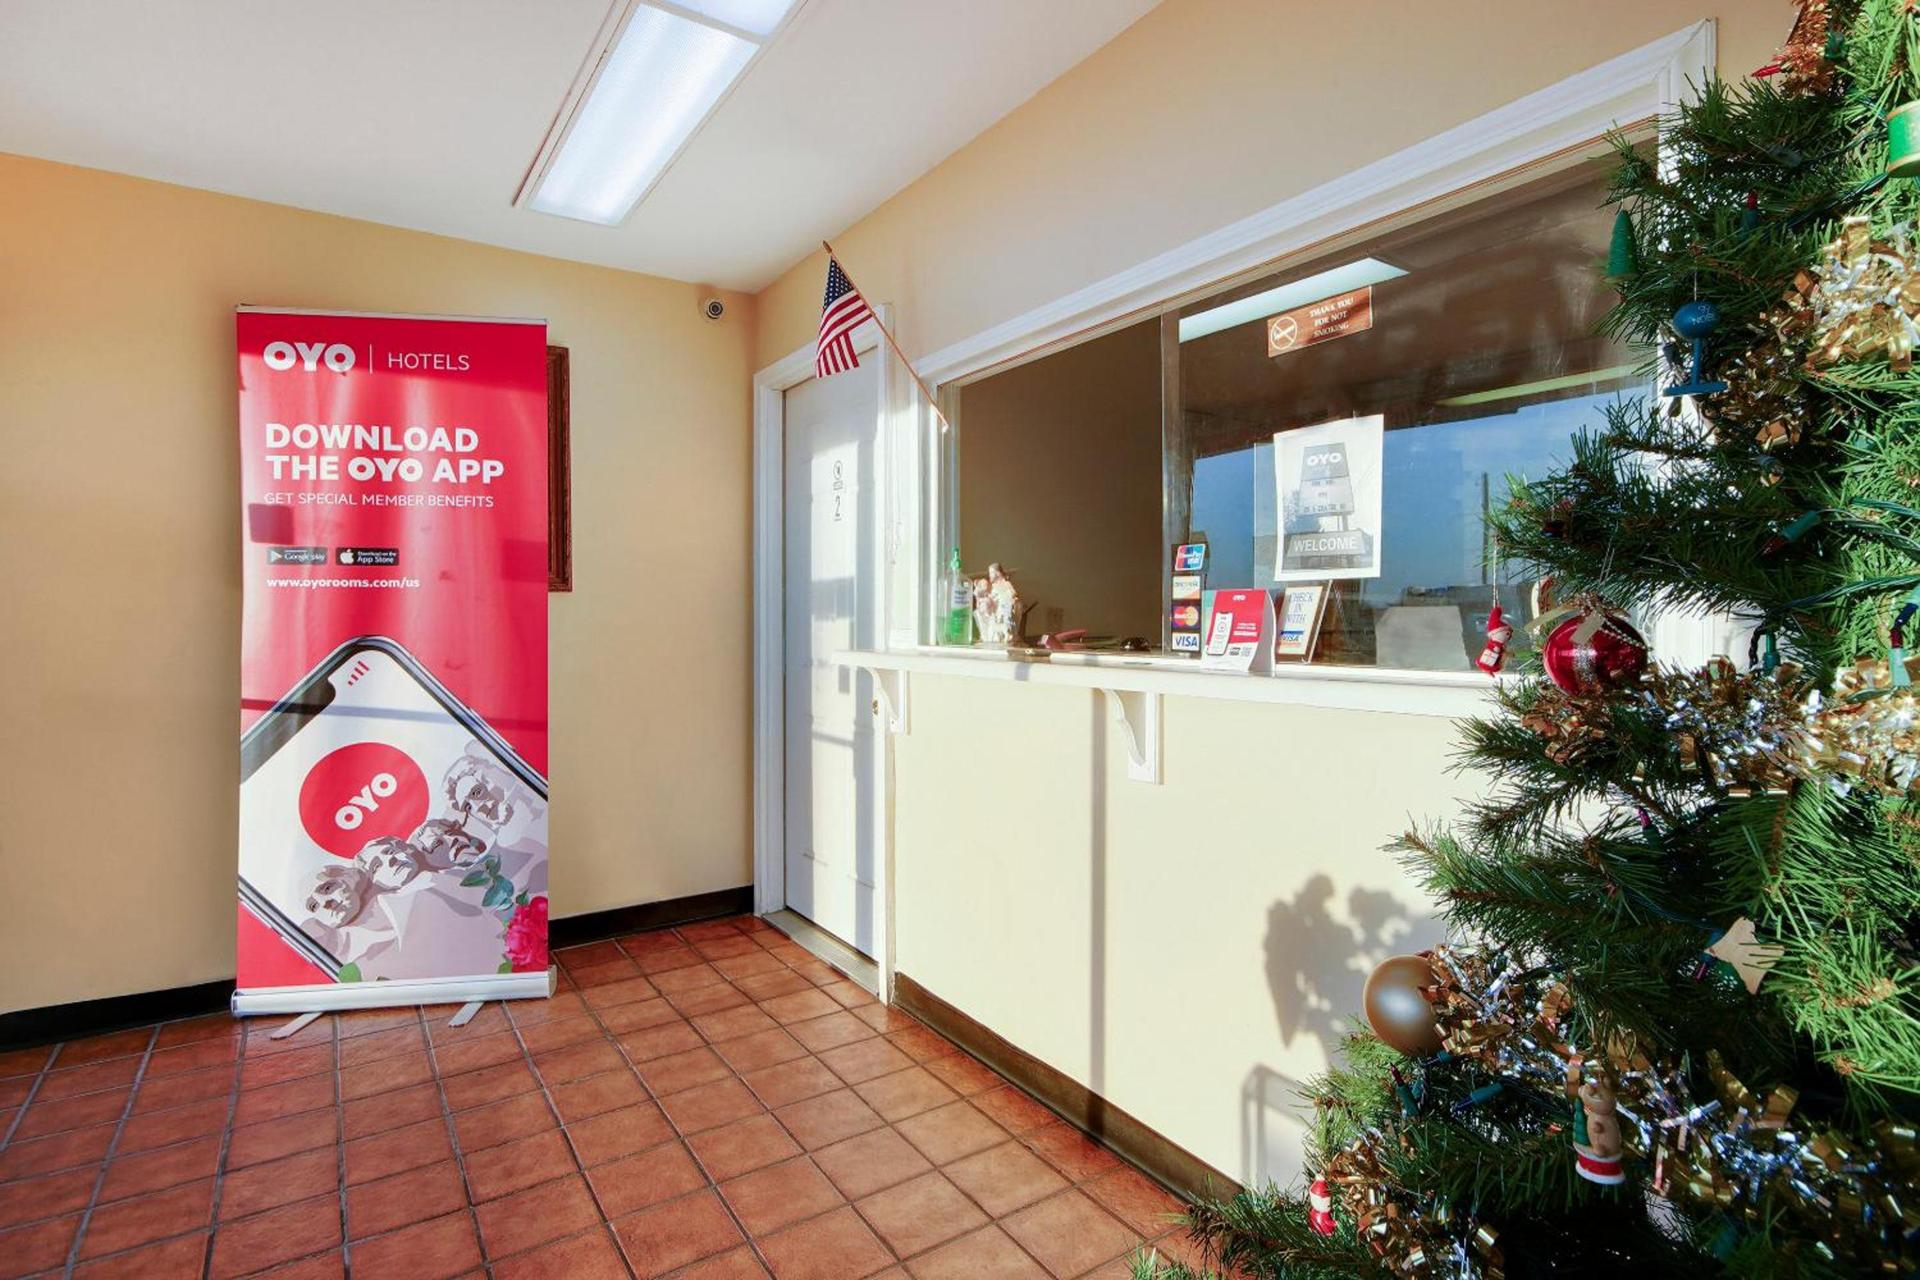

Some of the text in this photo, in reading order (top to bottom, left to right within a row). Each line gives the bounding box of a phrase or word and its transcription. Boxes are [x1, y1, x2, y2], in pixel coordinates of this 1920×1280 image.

[1310, 297, 1354, 317] THANK YOU
[1313, 310, 1348, 327] FOR NOT
[1313, 321, 1349, 337] SMOKING
[263, 341, 471, 372] OYO HOTELS
[265, 423, 479, 453] DOWNLOAD
[1307, 452, 1342, 466] OYO
[265, 455, 505, 484] THE OYO APP
[263, 492, 494, 508] GET SPECIAL MEMBER BENEFITS
[1293, 536, 1359, 552] WELCOME
[357, 556, 373, 564] App
[266, 577, 420, 590] www.oyorooms.com/us
[1175, 636, 1198, 647] VISA
[335, 773, 398, 830] OYO
